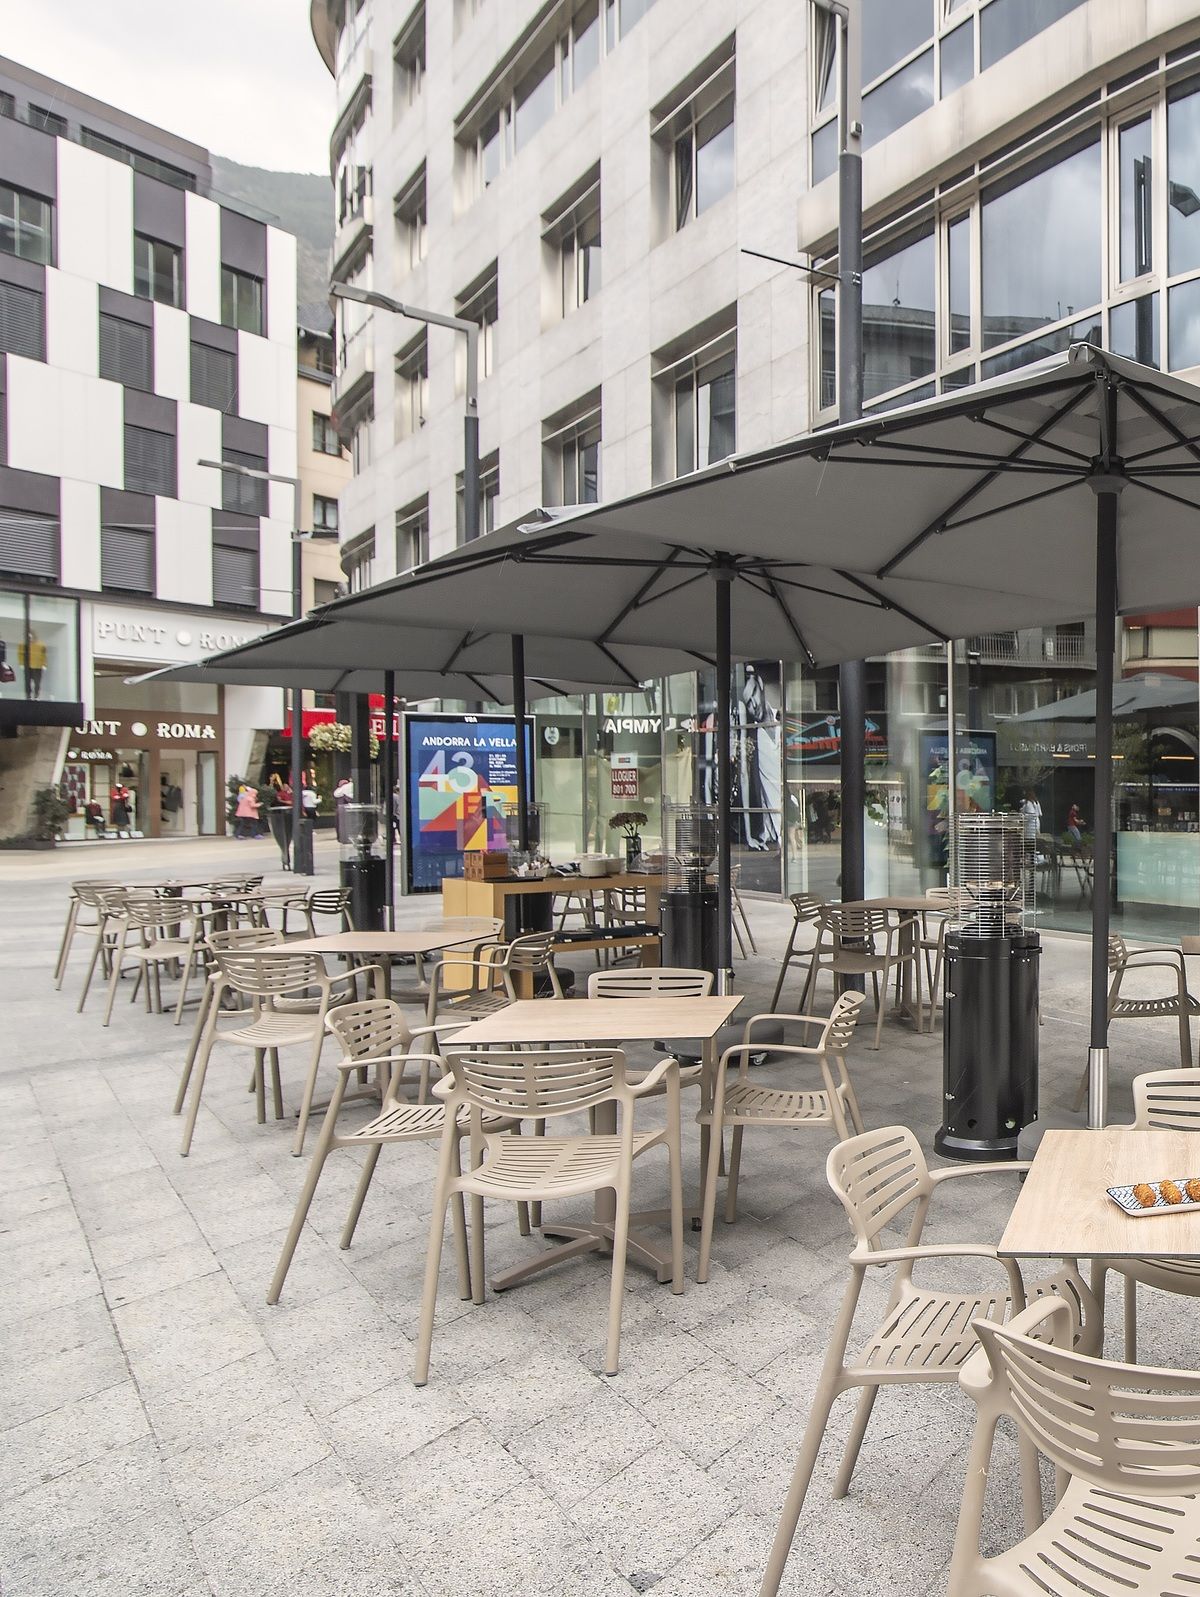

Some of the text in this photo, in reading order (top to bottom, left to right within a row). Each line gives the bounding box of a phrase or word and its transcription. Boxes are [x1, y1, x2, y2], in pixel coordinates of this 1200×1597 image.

[98, 621, 249, 651] PUNT ROM
[156, 723, 216, 739] ROMA
[422, 736, 517, 748] ANDORRA LA VELLA
